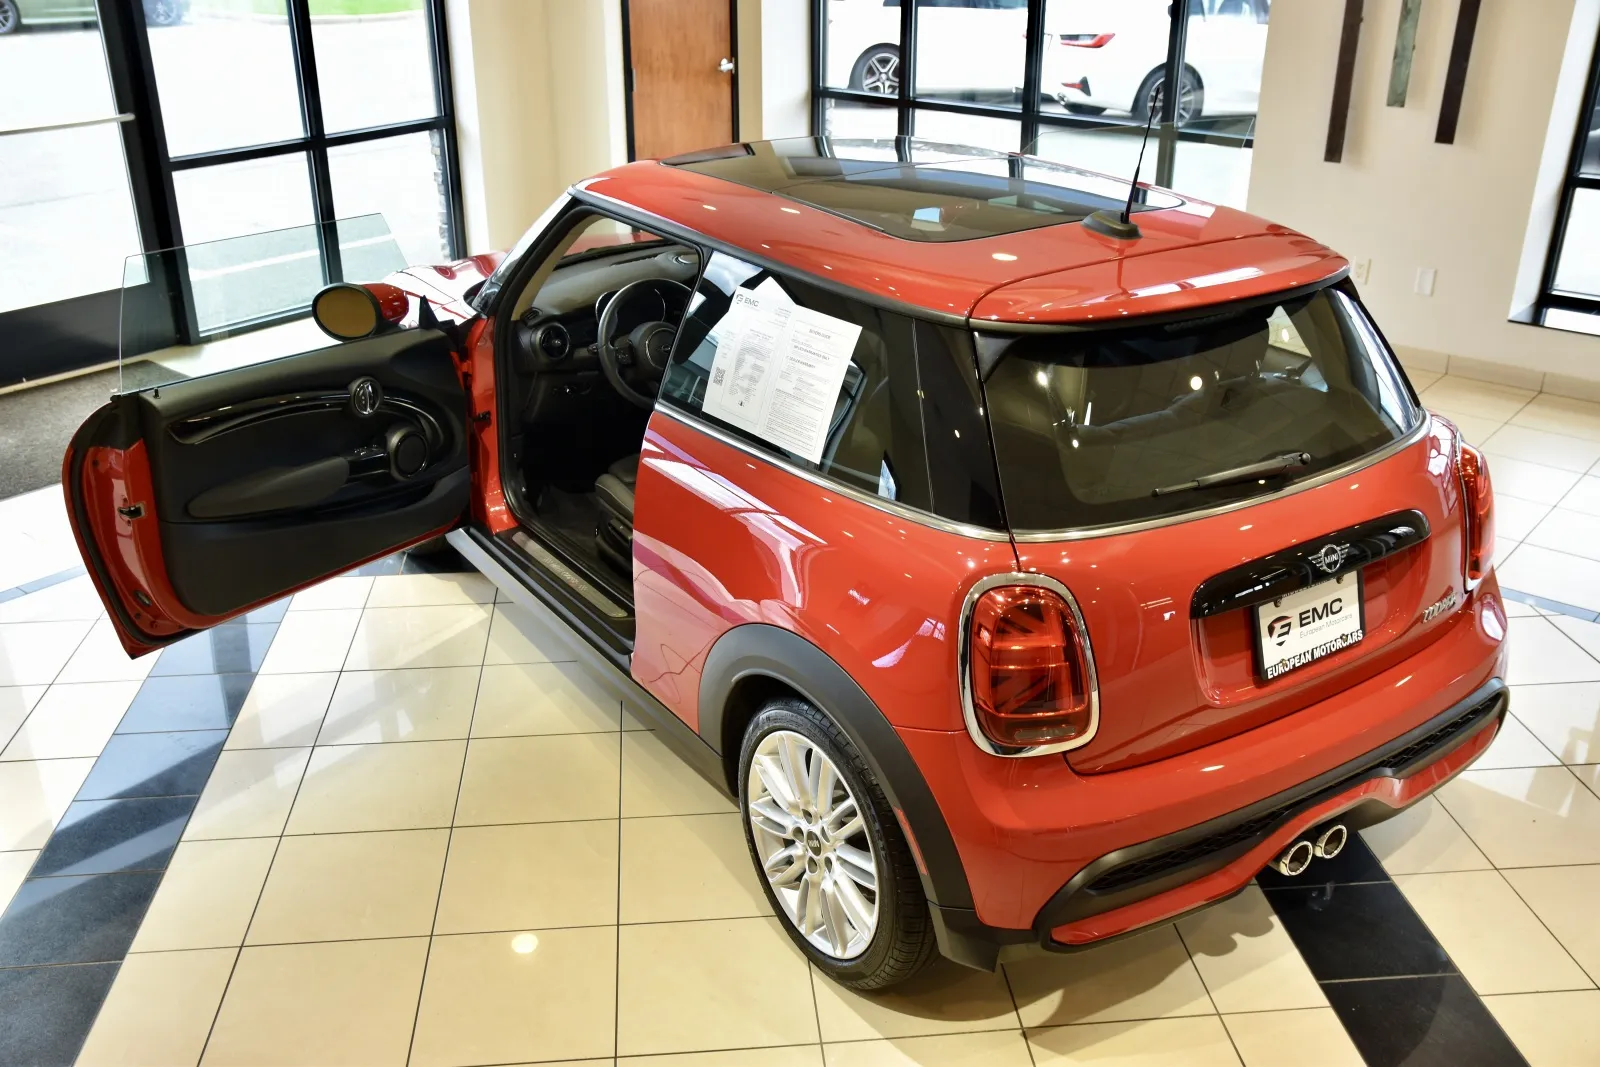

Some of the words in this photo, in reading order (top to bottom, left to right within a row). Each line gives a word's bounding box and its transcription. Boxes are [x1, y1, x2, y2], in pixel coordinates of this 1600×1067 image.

[744, 296, 760, 308] EMC
[1324, 552, 1339, 565] MINI
[1298, 597, 1343, 628] EMC
[1299, 623, 1326, 639] European
[1325, 613, 1353, 629] Motorcars
[1266, 649, 1313, 680] EUROPEAN
